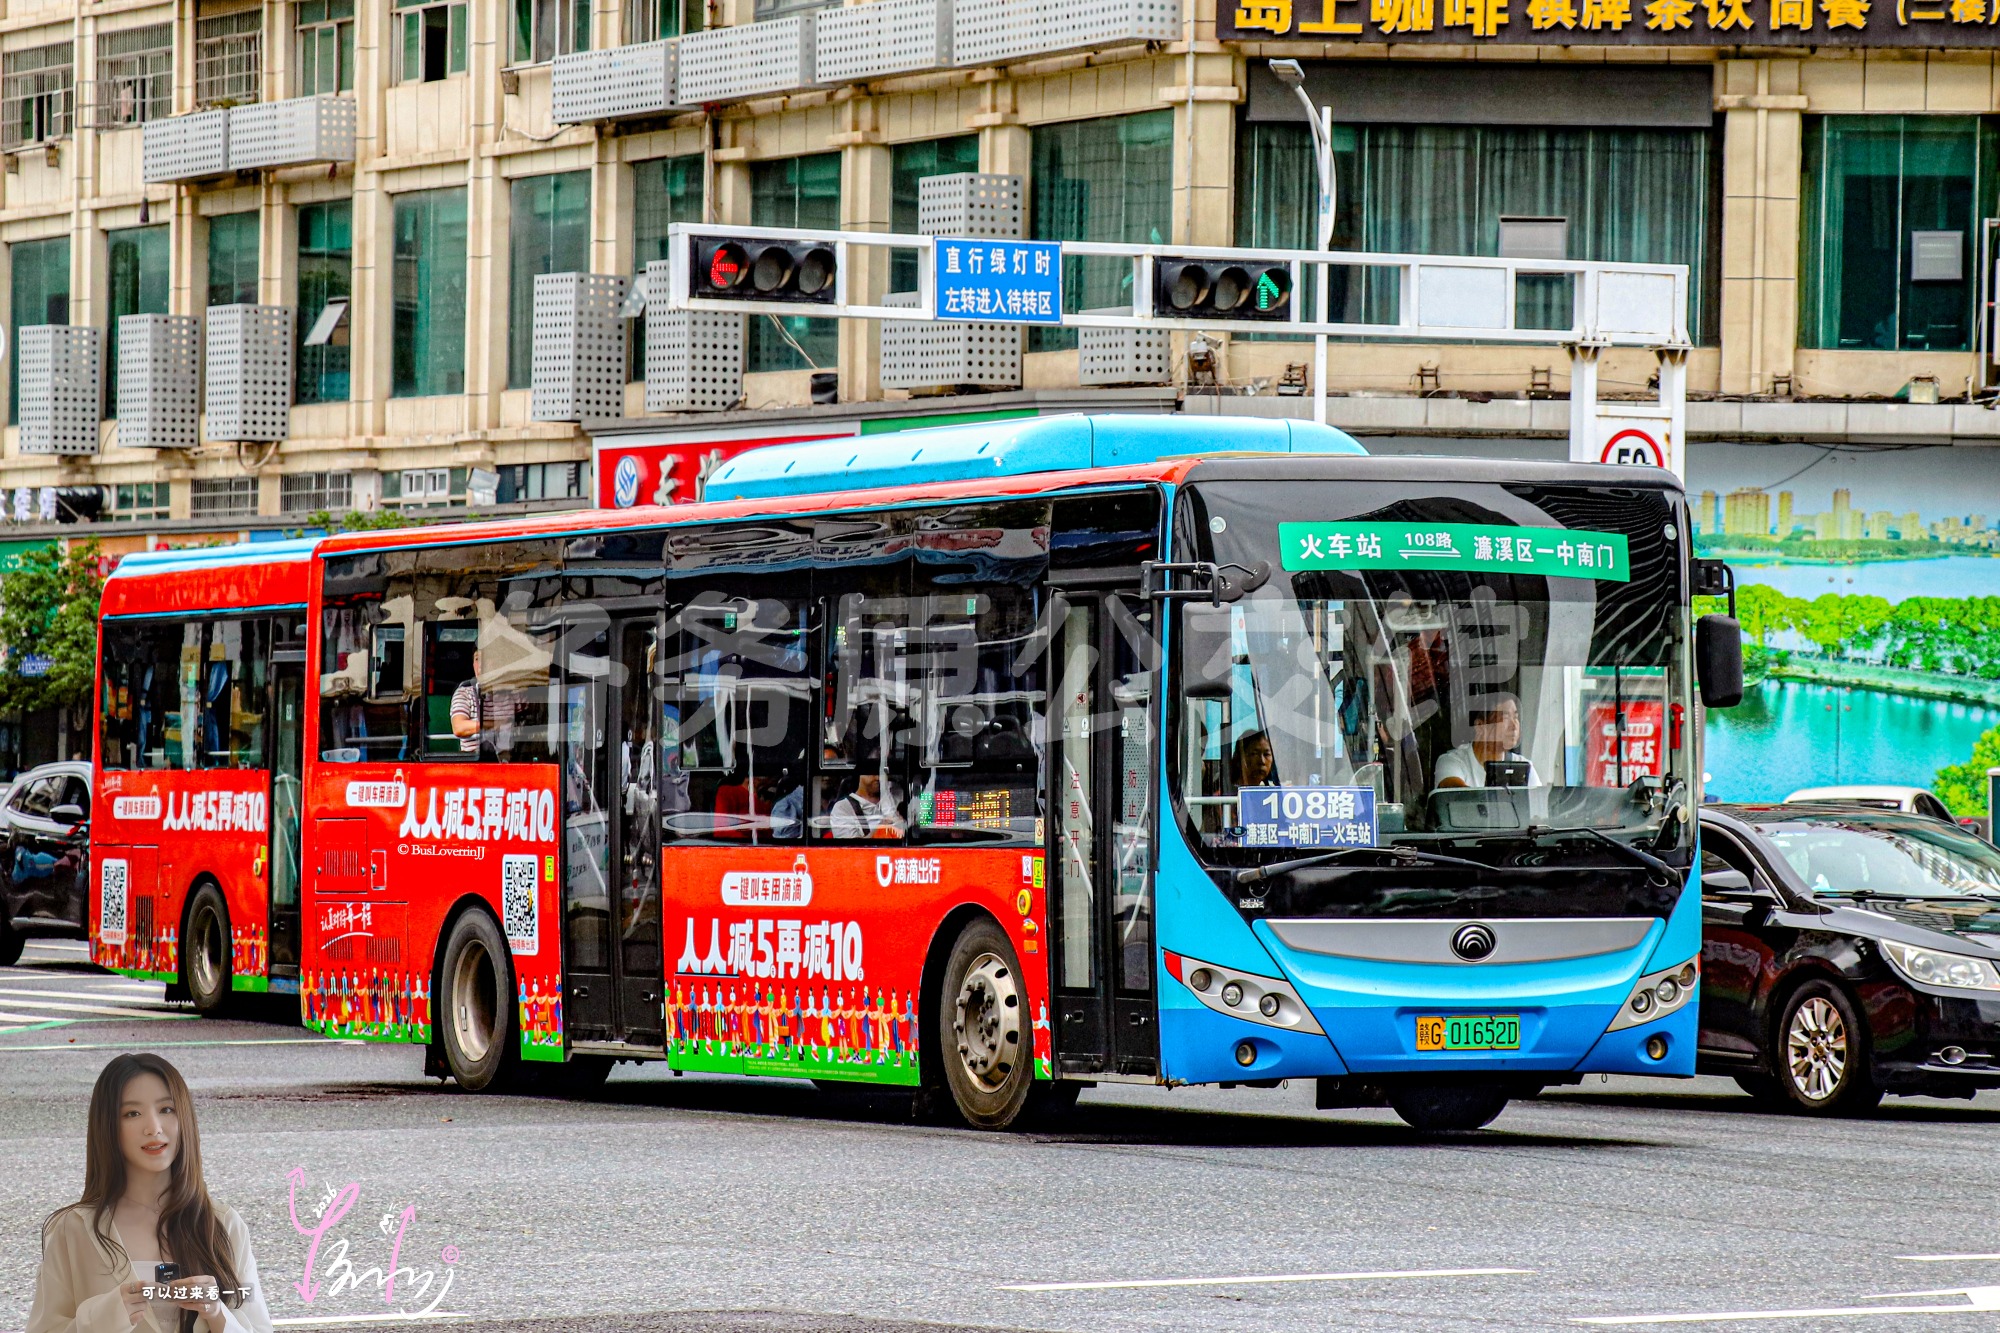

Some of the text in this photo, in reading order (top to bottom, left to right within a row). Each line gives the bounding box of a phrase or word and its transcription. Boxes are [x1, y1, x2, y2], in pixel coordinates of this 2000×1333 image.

[945, 245, 1051, 277] 直行绿灯时
[945, 286, 1053, 316] 左转进入待转区
[1299, 532, 1615, 570] 火车站 108路 濂溪区一中南门
[1262, 791, 1356, 820] 108路
[894, 857, 941, 885] 滴滴出行
[729, 877, 803, 902] 一键叫车用滴滴
